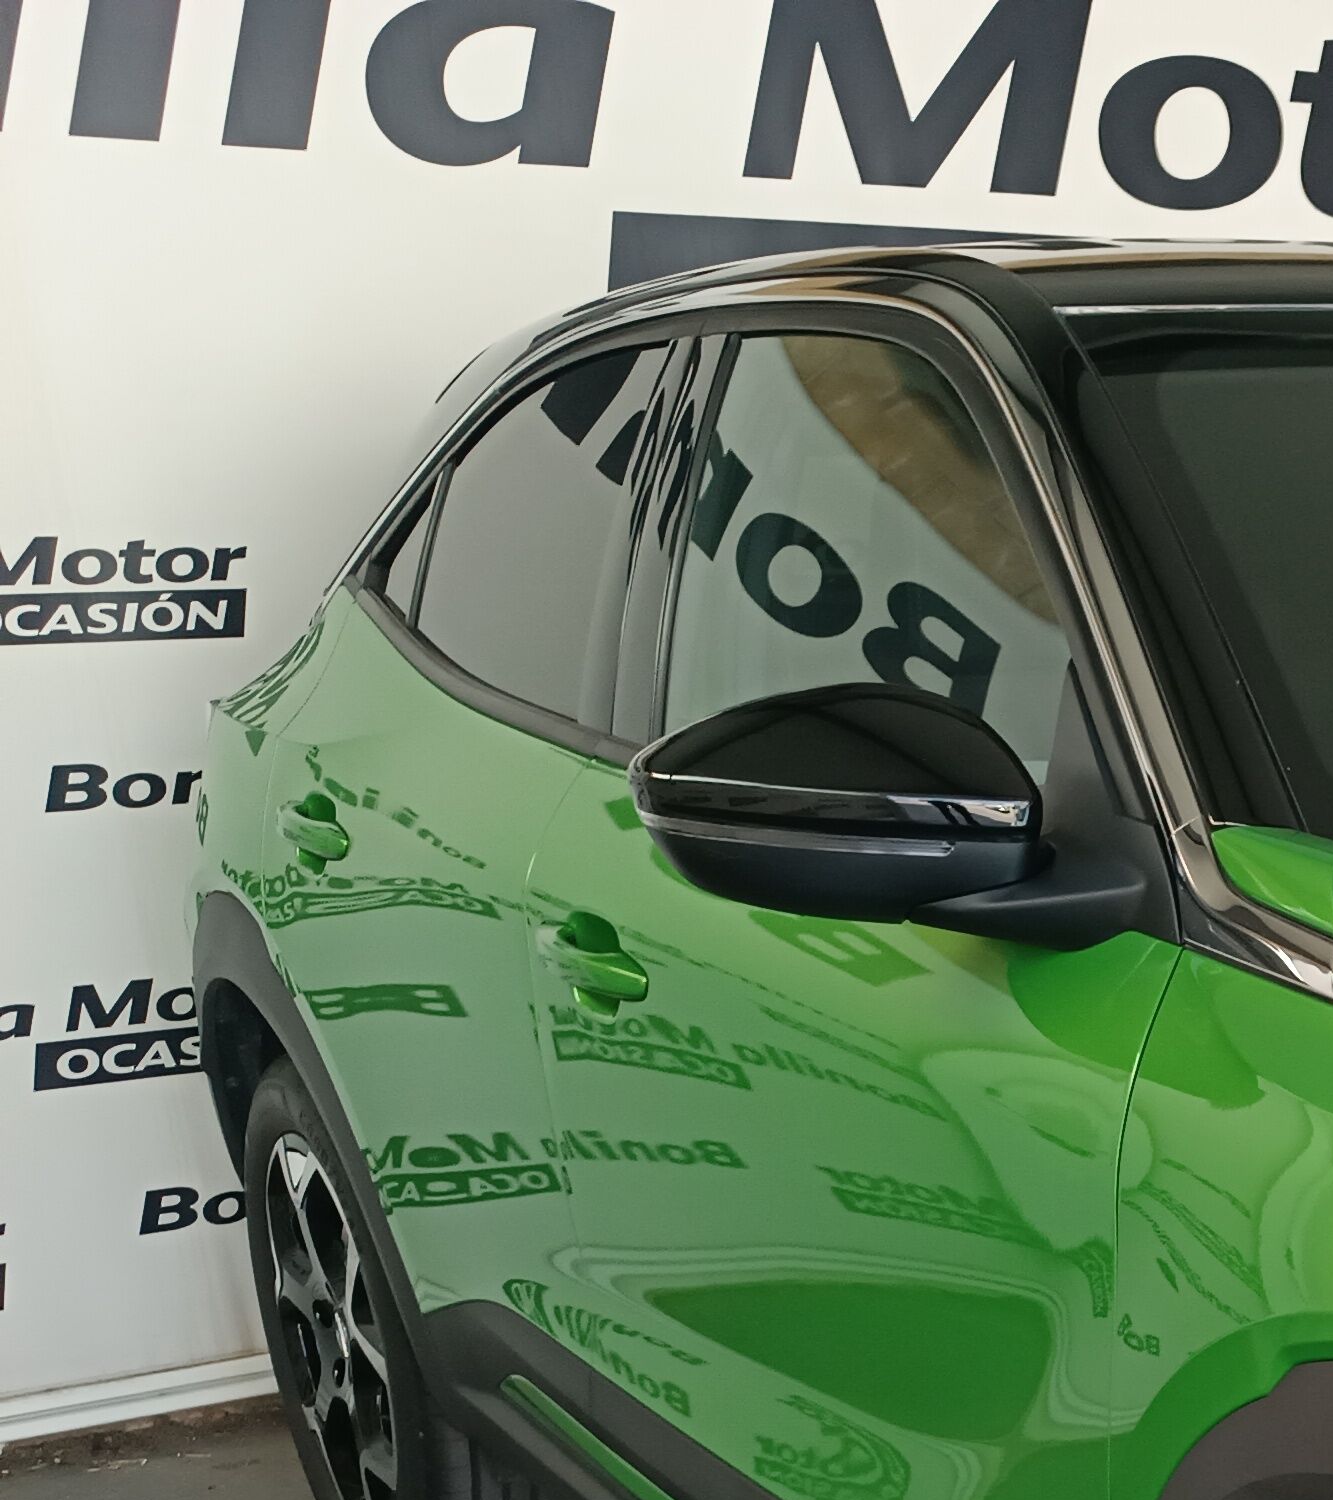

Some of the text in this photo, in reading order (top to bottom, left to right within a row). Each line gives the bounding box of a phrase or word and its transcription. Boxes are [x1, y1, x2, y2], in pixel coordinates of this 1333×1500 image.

[0, 0, 614, 167] lla
[0, 536, 248, 586] Motor
[0, 592, 228, 637] CASIÓN
